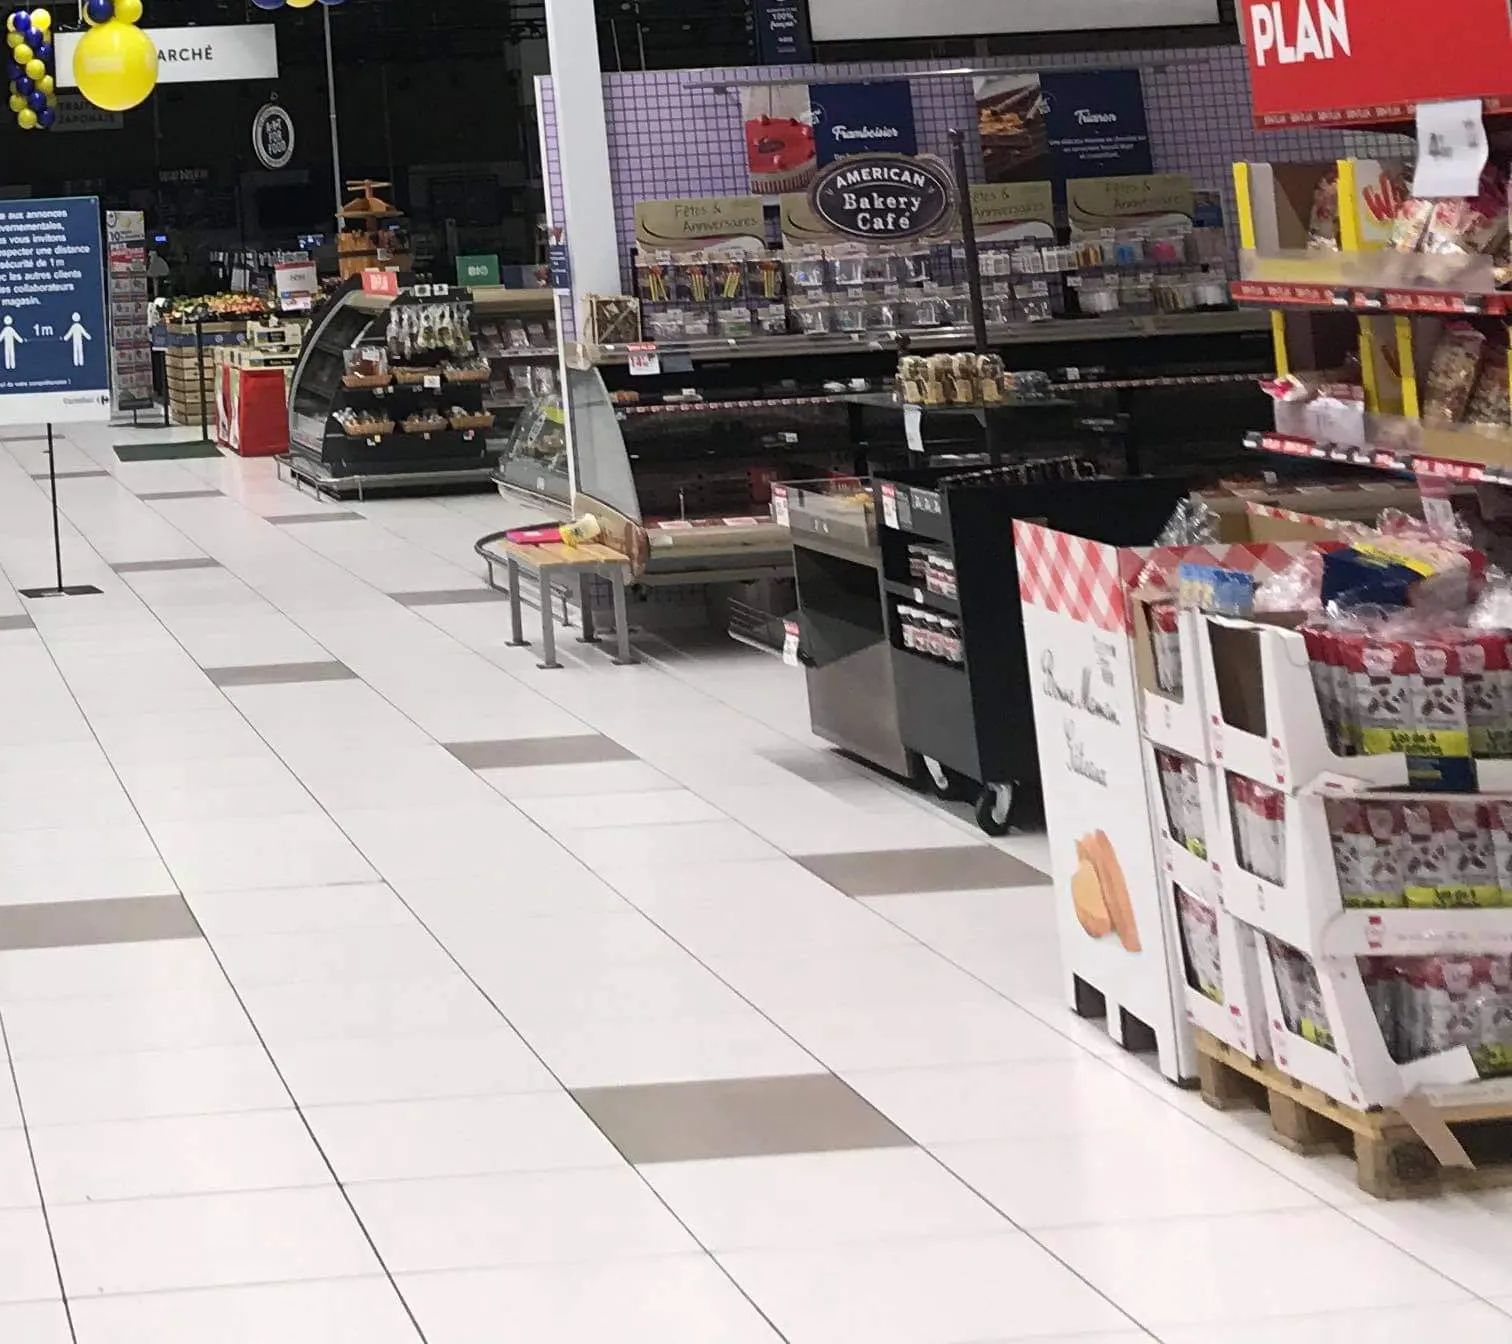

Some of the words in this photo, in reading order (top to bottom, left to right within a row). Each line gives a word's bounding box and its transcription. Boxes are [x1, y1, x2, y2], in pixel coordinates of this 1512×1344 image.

[156, 44, 214, 62] ARCHÉ
[836, 167, 926, 189] AMERICAN
[843, 192, 922, 212] Bakery
[8, 212, 24, 220] aux
[26, 210, 68, 219] annonces
[674, 204, 709, 217] Fêtes
[713, 202, 722, 214] &
[857, 212, 910, 231] Café
[8, 236, 31, 244] vous
[32, 234, 67, 243] invitons
[35, 247, 52, 255] une
[54, 245, 90, 254] distance
[0, 259, 34, 269] sécurité
[36, 259, 48, 268] de
[9, 272, 22, 281] les
[24, 272, 51, 281] autres
[53, 270, 82, 279] clients
[13, 283, 75, 293] collaborateurs
[1, 296, 41, 308] magasin.
[33, 324, 54, 337] 1m
